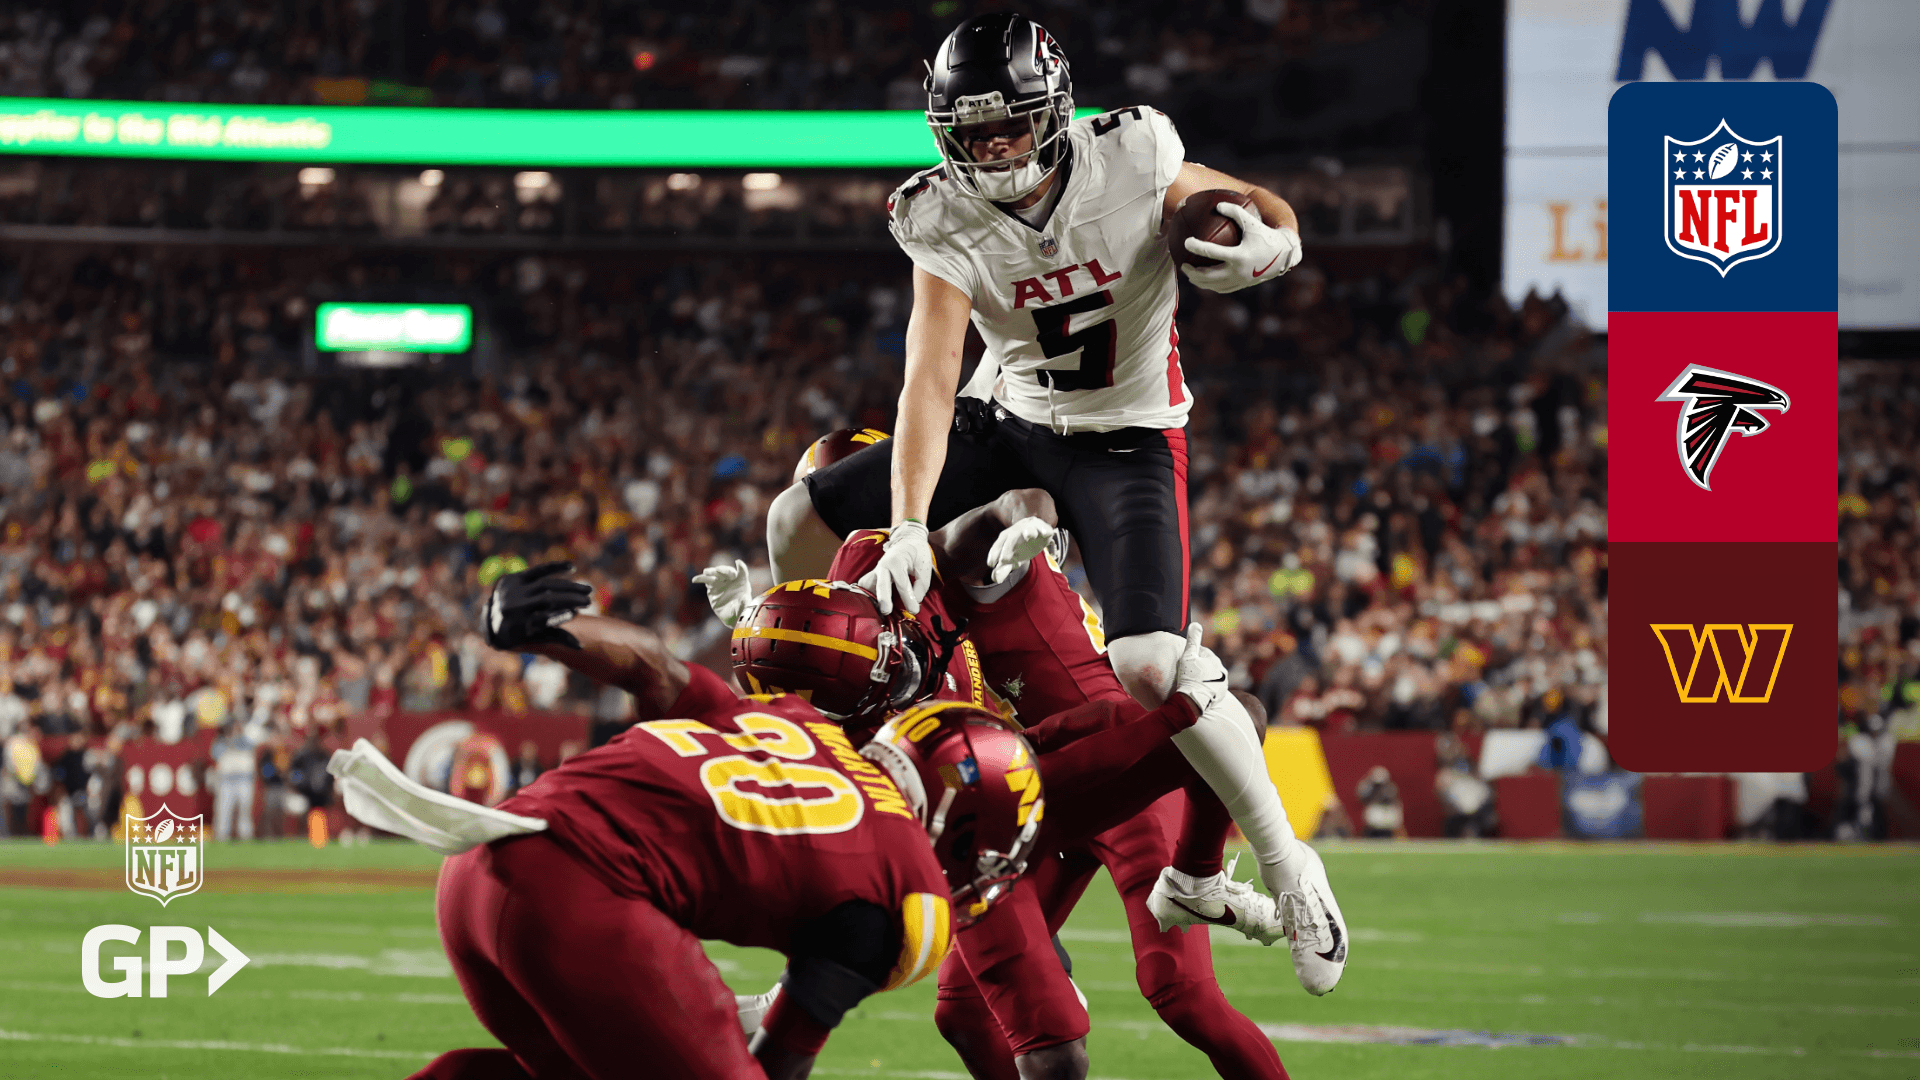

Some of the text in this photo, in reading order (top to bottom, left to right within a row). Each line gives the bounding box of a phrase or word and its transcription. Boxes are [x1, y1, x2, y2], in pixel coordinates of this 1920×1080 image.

[968, 98, 993, 108] ATL
[1011, 258, 1121, 310] ATL
[1031, 290, 1118, 392] 5
[635, 711, 866, 836] 20
[802, 721, 914, 820] MARTIN
